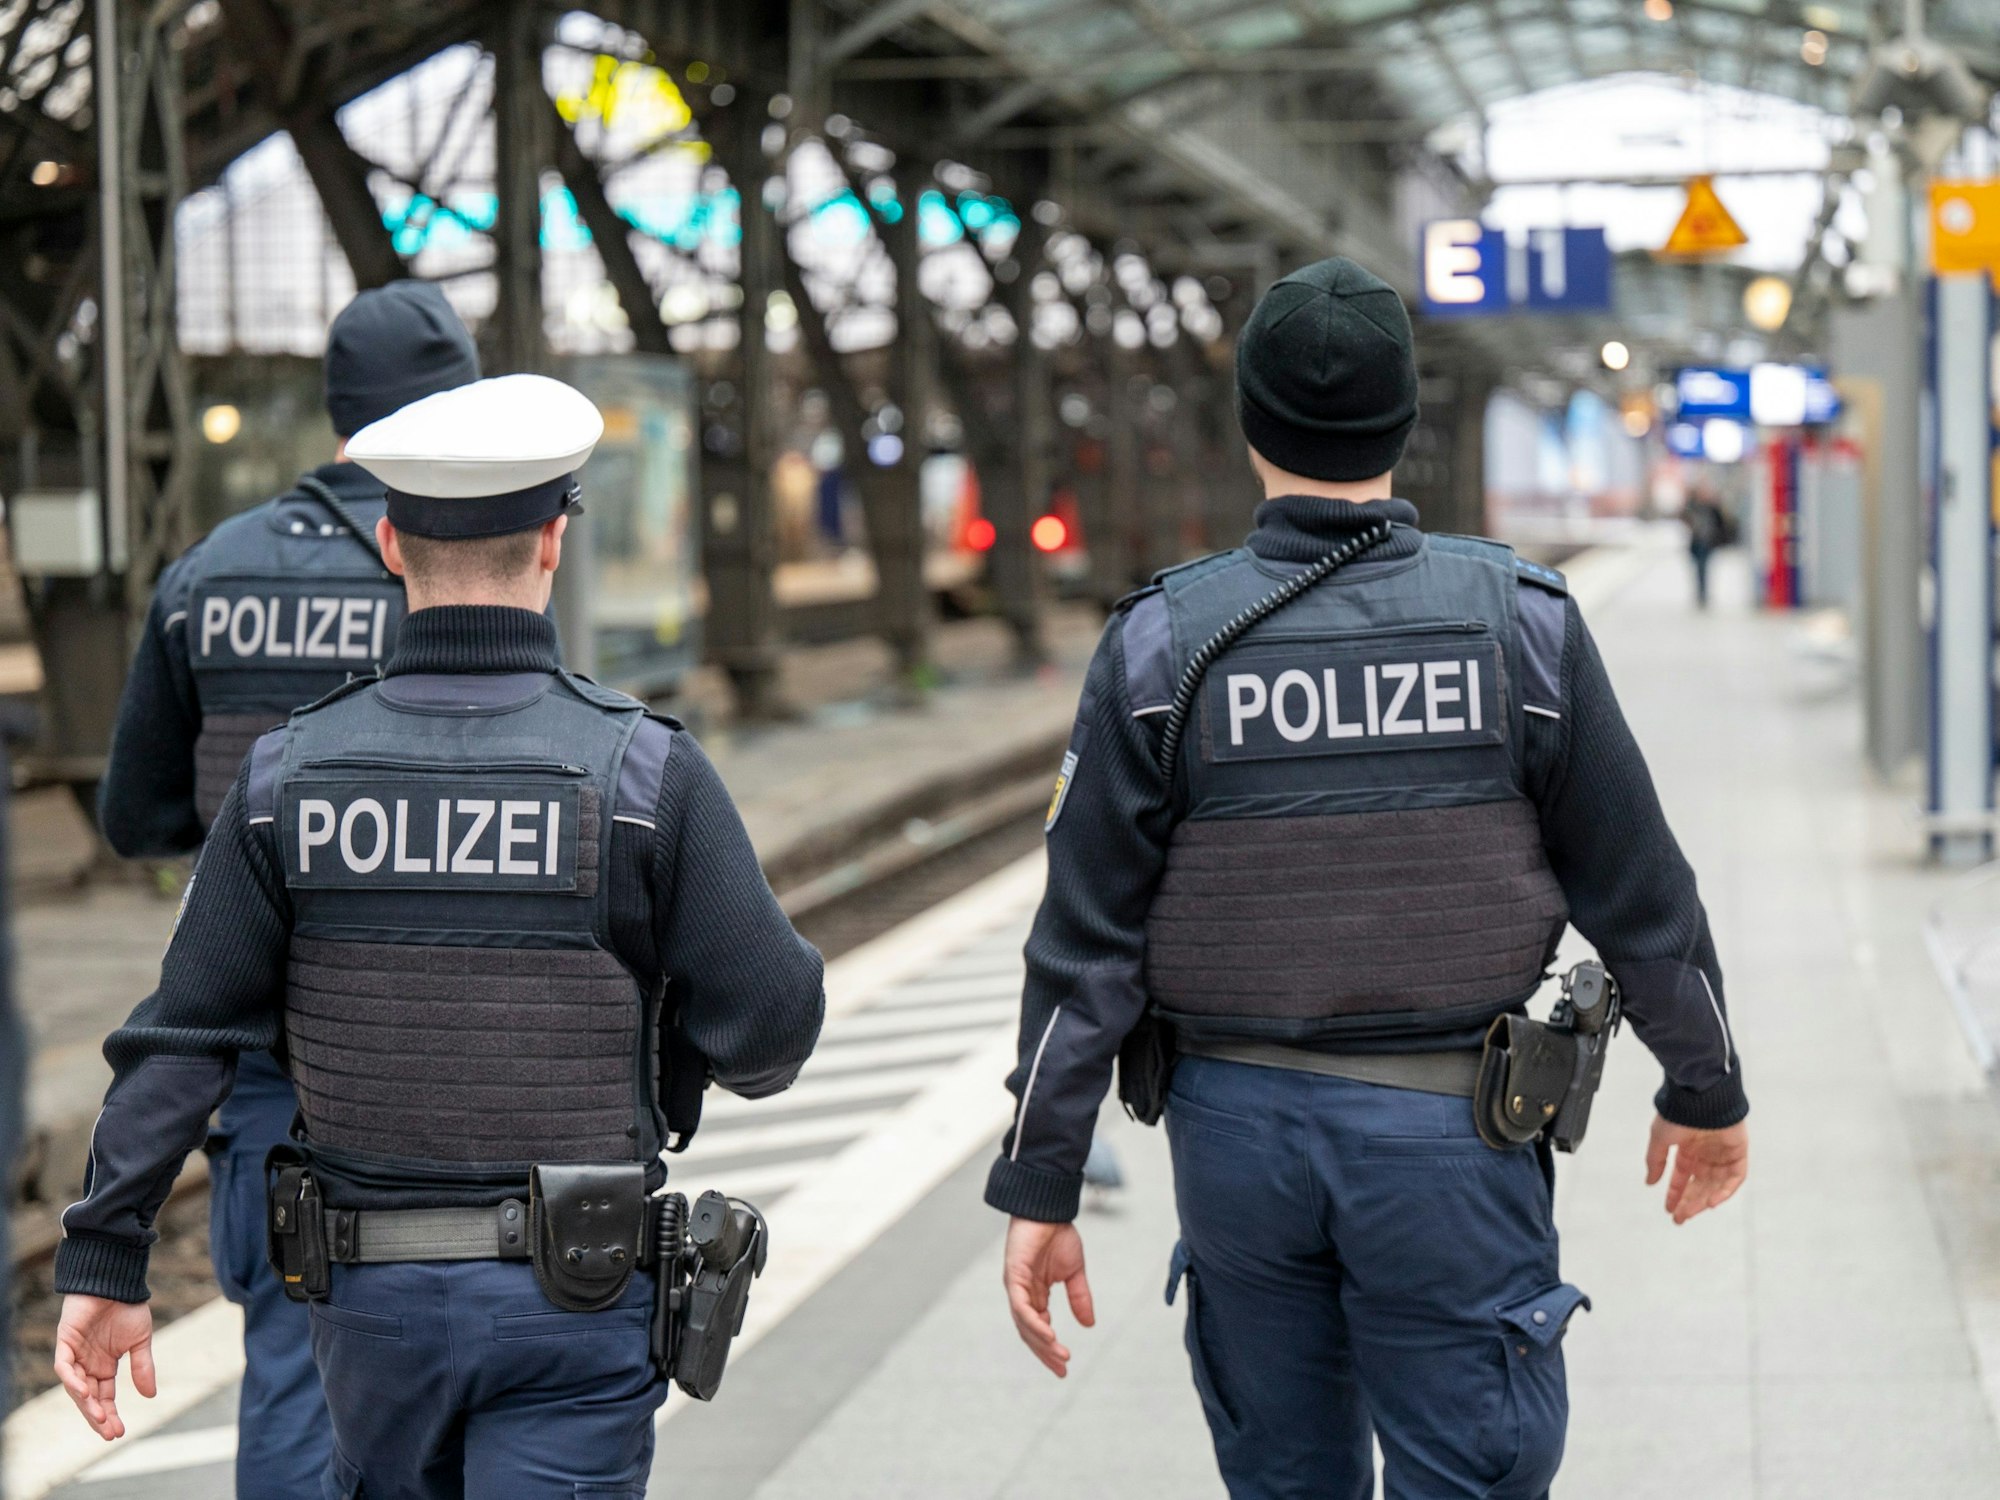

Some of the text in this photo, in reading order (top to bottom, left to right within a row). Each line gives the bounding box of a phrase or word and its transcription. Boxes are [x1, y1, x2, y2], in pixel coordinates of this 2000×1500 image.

[1425, 219, 1485, 303] E
[201, 596, 388, 659] POLIZEI
[1227, 659, 1482, 745] POLIZEI
[299, 797, 560, 876] POLIZEI
